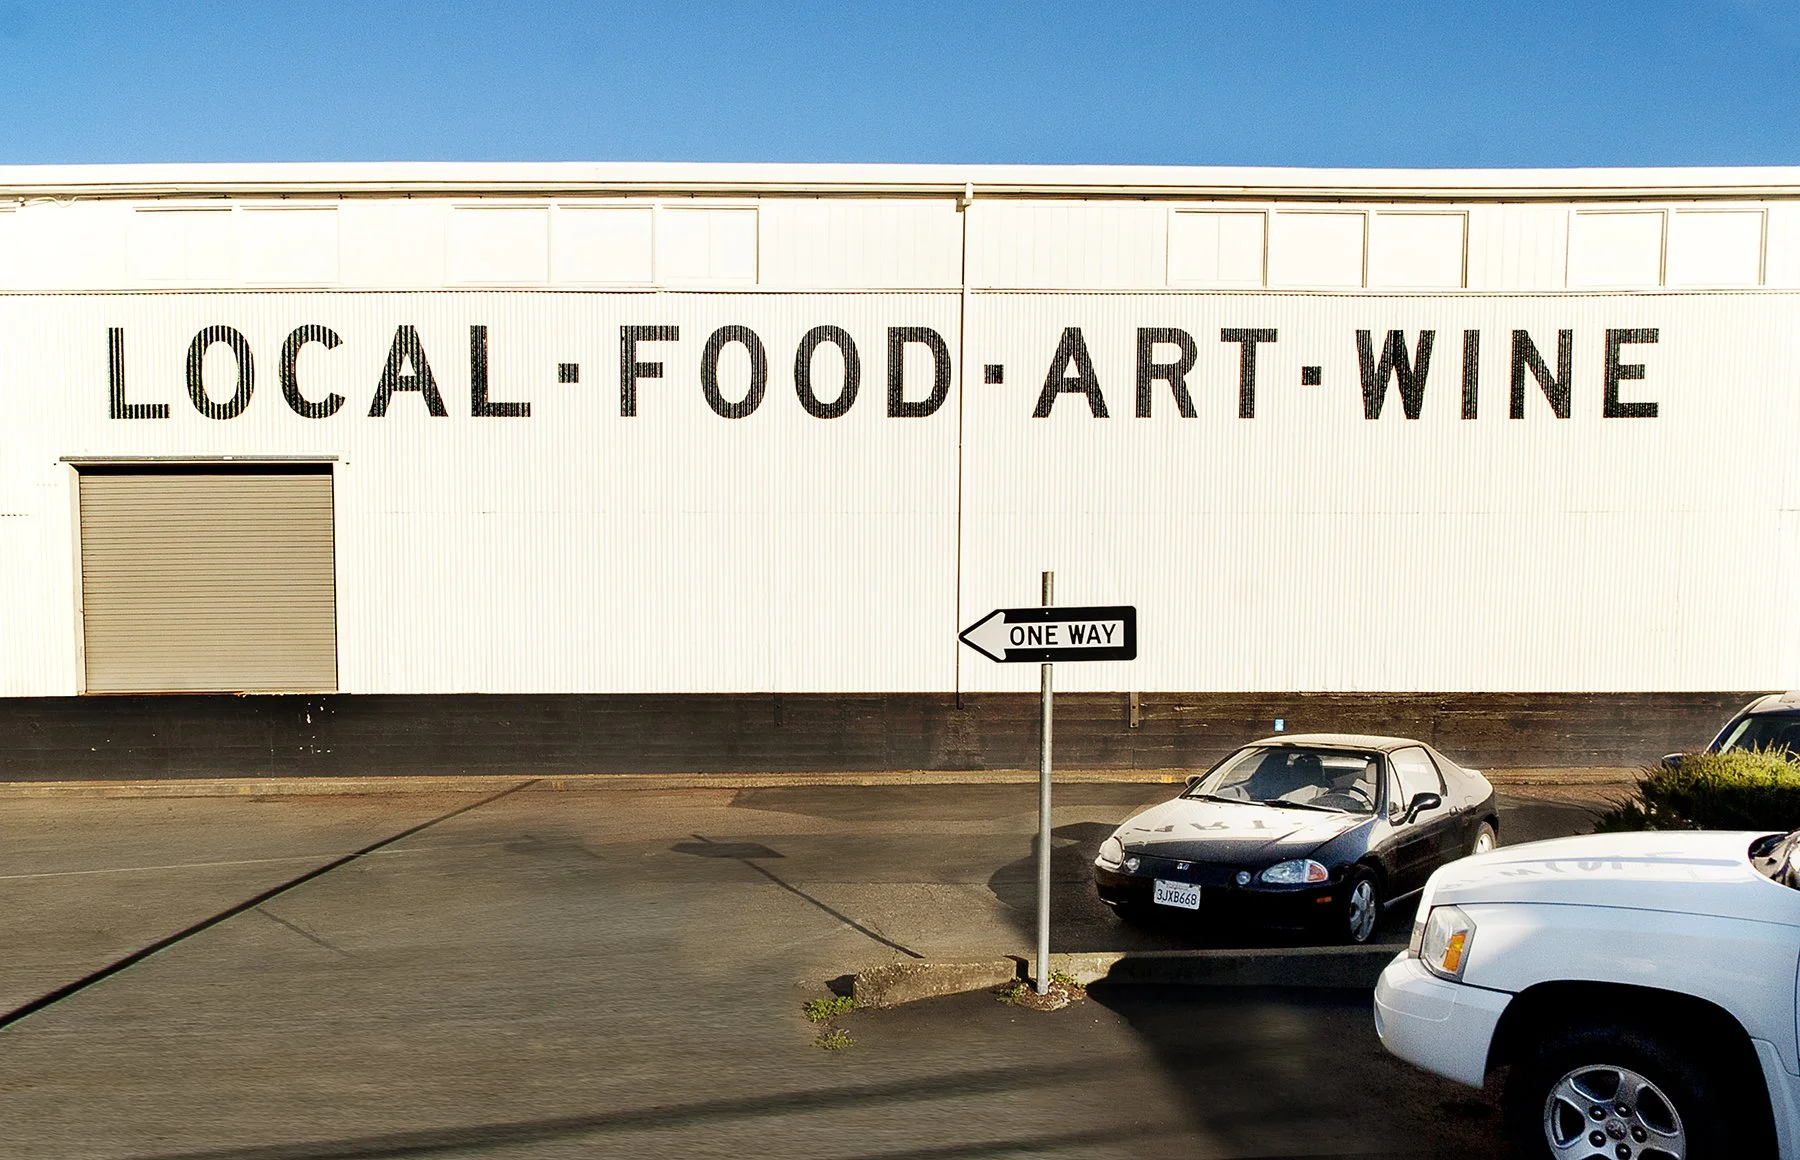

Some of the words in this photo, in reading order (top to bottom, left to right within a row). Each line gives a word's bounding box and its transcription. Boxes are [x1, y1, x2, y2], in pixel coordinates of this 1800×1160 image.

[109, 325, 531, 420] LOCAL
[620, 325, 952, 420] FOOD
[1032, 327, 1278, 419] ART
[1356, 329, 1660, 420] WINE
[1009, 625, 1058, 646] ONE
[1068, 623, 1116, 645] WAY
[1156, 888, 1197, 905] 3JXB668
